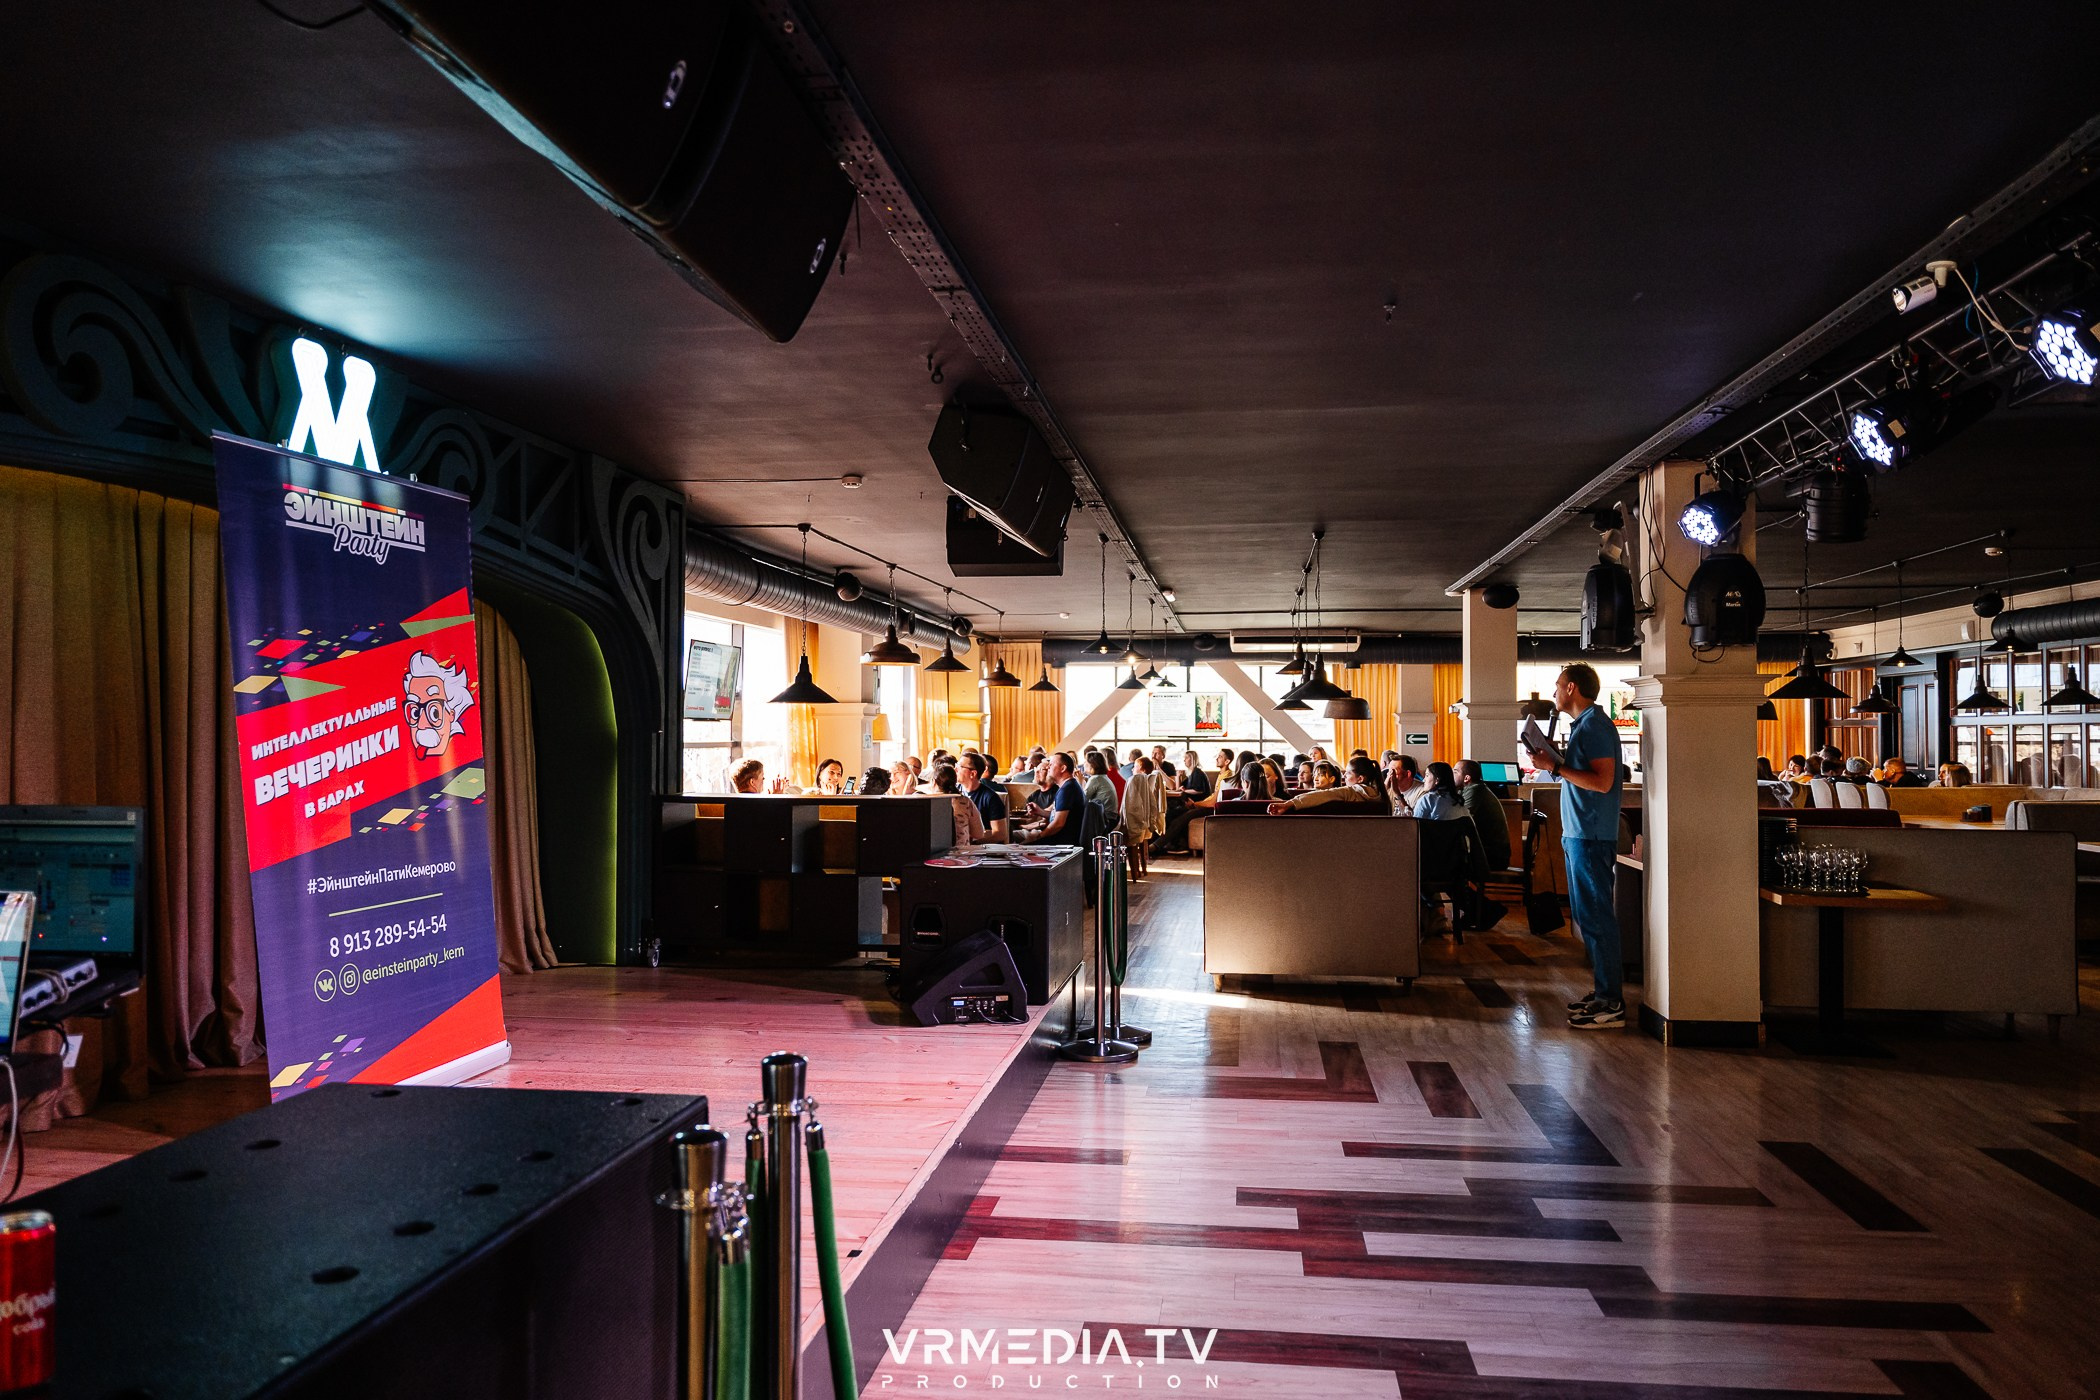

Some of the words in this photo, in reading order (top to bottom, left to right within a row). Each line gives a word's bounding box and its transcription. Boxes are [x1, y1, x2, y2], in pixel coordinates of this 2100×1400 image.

[333, 523, 392, 565] Party
[251, 697, 397, 761] ИНТЕЛЛЕКТУАЛЬНЫЕ
[254, 725, 400, 806] ВЕЧЕРИНКИ
[304, 802, 316, 818] В
[317, 780, 365, 813] БАРАХ
[307, 861, 456, 895] #ЭйнштейнПатиКемерово
[329, 936, 340, 958] 8
[343, 930, 372, 955] 913
[375, 913, 447, 948] 289-54-54
[362, 946, 465, 985] @einsteinparty_kem
